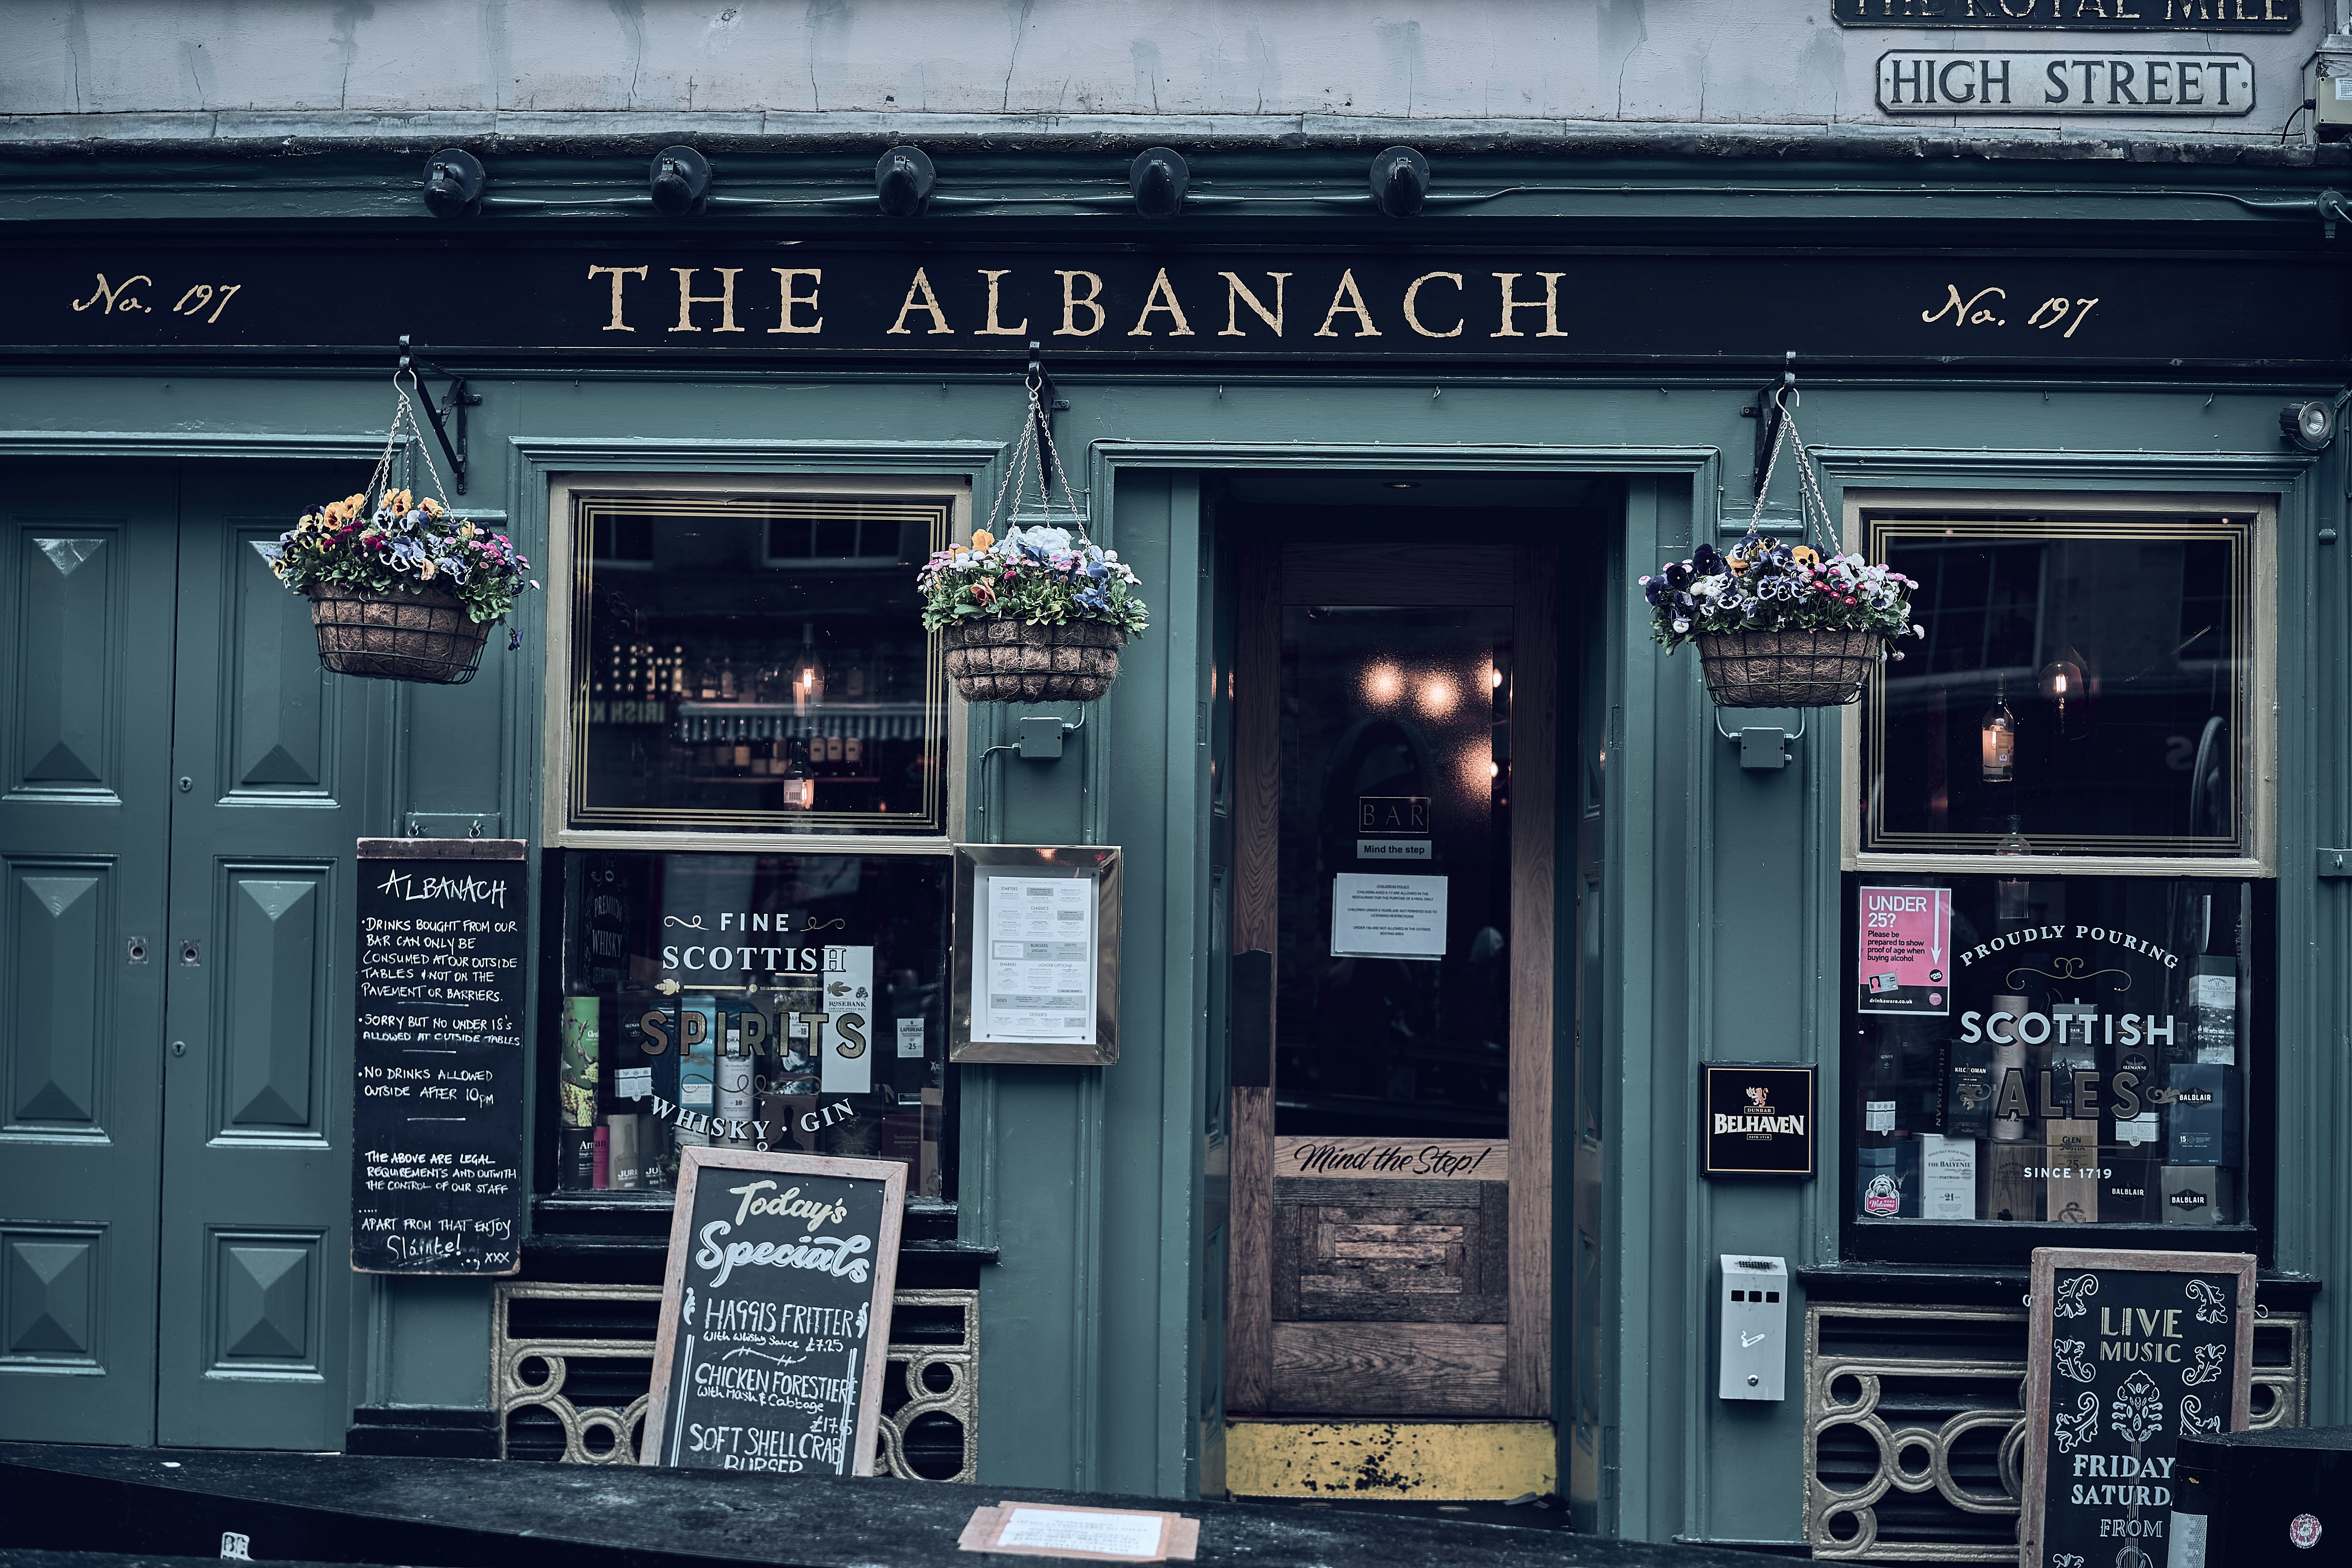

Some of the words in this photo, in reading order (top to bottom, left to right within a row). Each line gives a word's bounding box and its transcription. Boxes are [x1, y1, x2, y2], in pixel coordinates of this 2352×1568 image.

[1890, 59, 2011, 104] HIGH
[2045, 59, 2239, 105] STREET
[173, 284, 241, 323] 197
[588, 264, 823, 334] THE
[886, 267, 1568, 338] ALBANACH
[2028, 298, 2099, 338] 197
[1364, 804, 1423, 826] BAR
[1388, 845, 1403, 853] the
[1405, 846, 1425, 855] step
[377, 869, 507, 909] ALBANACH
[1869, 895, 1927, 912] UNDER
[366, 917, 411, 931] DRINKS
[416, 919, 461, 933] BOUGHT
[463, 920, 490, 933] FROM
[494, 921, 517, 932] OUR
[721, 913, 789, 931] FINE
[1868, 912, 1896, 928] 25?
[366, 934, 390, 947] BAR
[396, 935, 421, 947] CAN
[423, 937, 455, 956] ONLY
[458, 938, 476, 949] BE
[1960, 924, 2066, 967] PROUDLY
[2076, 924, 2179, 969] POURING
[363, 950, 429, 964] CONSUMED
[433, 954, 448, 965] AT
[448, 956, 469, 967] OUR
[472, 957, 517, 969] OUTSIDE
[662, 946, 846, 972] SCOTTISH
[1867, 954, 1889, 962] buying
[361, 967, 414, 979] TABLES
[429, 971, 452, 982] NOT
[454, 972, 468, 982] ON
[472, 971, 495, 982] THE
[361, 982, 426, 998] PAVEMENT
[428, 988, 443, 998] OR
[447, 988, 503, 1002] BARRIERS.
[365, 1014, 404, 1030] SORRY
[408, 1016, 429, 1027] BUT
[433, 1017, 447, 1029] NO
[452, 1019, 487, 1031] UNDER
[492, 1014, 512, 1030] 18's
[1960, 1011, 2174, 1046] SCOTTISH
[363, 1031, 411, 1041] ALLOWED
[417, 1033, 431, 1041] AT
[434, 1033, 481, 1042] OUTSIDE
[484, 1035, 520, 1046] TABLES
[640, 1010, 868, 1059] SPIRITS
[364, 1066, 382, 1078] NO
[387, 1067, 430, 1080] DRINKS
[438, 1069, 493, 1081] ALLOWED
[365, 1085, 410, 1097] OUTSIDE
[419, 1086, 457, 1100] AFTER
[1998, 1070, 2141, 1118] ALES
[650, 1094, 771, 1140] WHISKY
[800, 1098, 855, 1133] GIN
[1714, 1113, 1804, 1135] BELHAVEN
[365, 1150, 389, 1163] THE
[390, 1152, 426, 1164] ABOVE
[430, 1153, 452, 1165] ARE
[459, 1153, 496, 1165] LEGAL
[1294, 1144, 1377, 1173] Mind
[1373, 1146, 1414, 1171] the
[1412, 1145, 1492, 1177] Step!
[367, 1166, 448, 1178] REQUIREMENTS
[452, 1168, 475, 1178] AND
[477, 1169, 516, 1179] OUTWITH
[618, 1169, 638, 1177] JURA
[2023, 1167, 2073, 1179] SINCE
[2079, 1168, 2112, 1179] 1719
[365, 1180, 385, 1191] THE
[387, 1181, 431, 1190] CONTROL
[436, 1181, 449, 1191] OF
[451, 1183, 472, 1192] OUR
[476, 1183, 508, 1194] STAFF
[1944, 1193, 1954, 1201] 21
[729, 1180, 847, 1232] Today's
[361, 1218, 397, 1231] APART
[403, 1218, 431, 1230] FROM
[438, 1219, 473, 1232] THAT
[474, 1218, 511, 1240] ENJOY
[695, 1220, 871, 1288] Specials
[705, 1298, 777, 1332] HAGGIS
[781, 1304, 853, 1338] FRITTER
[2101, 1307, 2183, 1338] LIVE
[805, 1337, 844, 1352] £7.25
[2100, 1341, 2181, 1363] MUSIC
[695, 1363, 769, 1395] CHICKEN
[768, 1393, 824, 1414] Cabbage
[689, 1423, 743, 1453] SOFT
[744, 1426, 797, 1458] SHELL
[798, 1433, 842, 1465] CRAB
[2073, 1454, 2175, 1479] FRIDAY
[2071, 1484, 2172, 1506] SATURD
[2100, 1518, 2163, 1538] FROM
